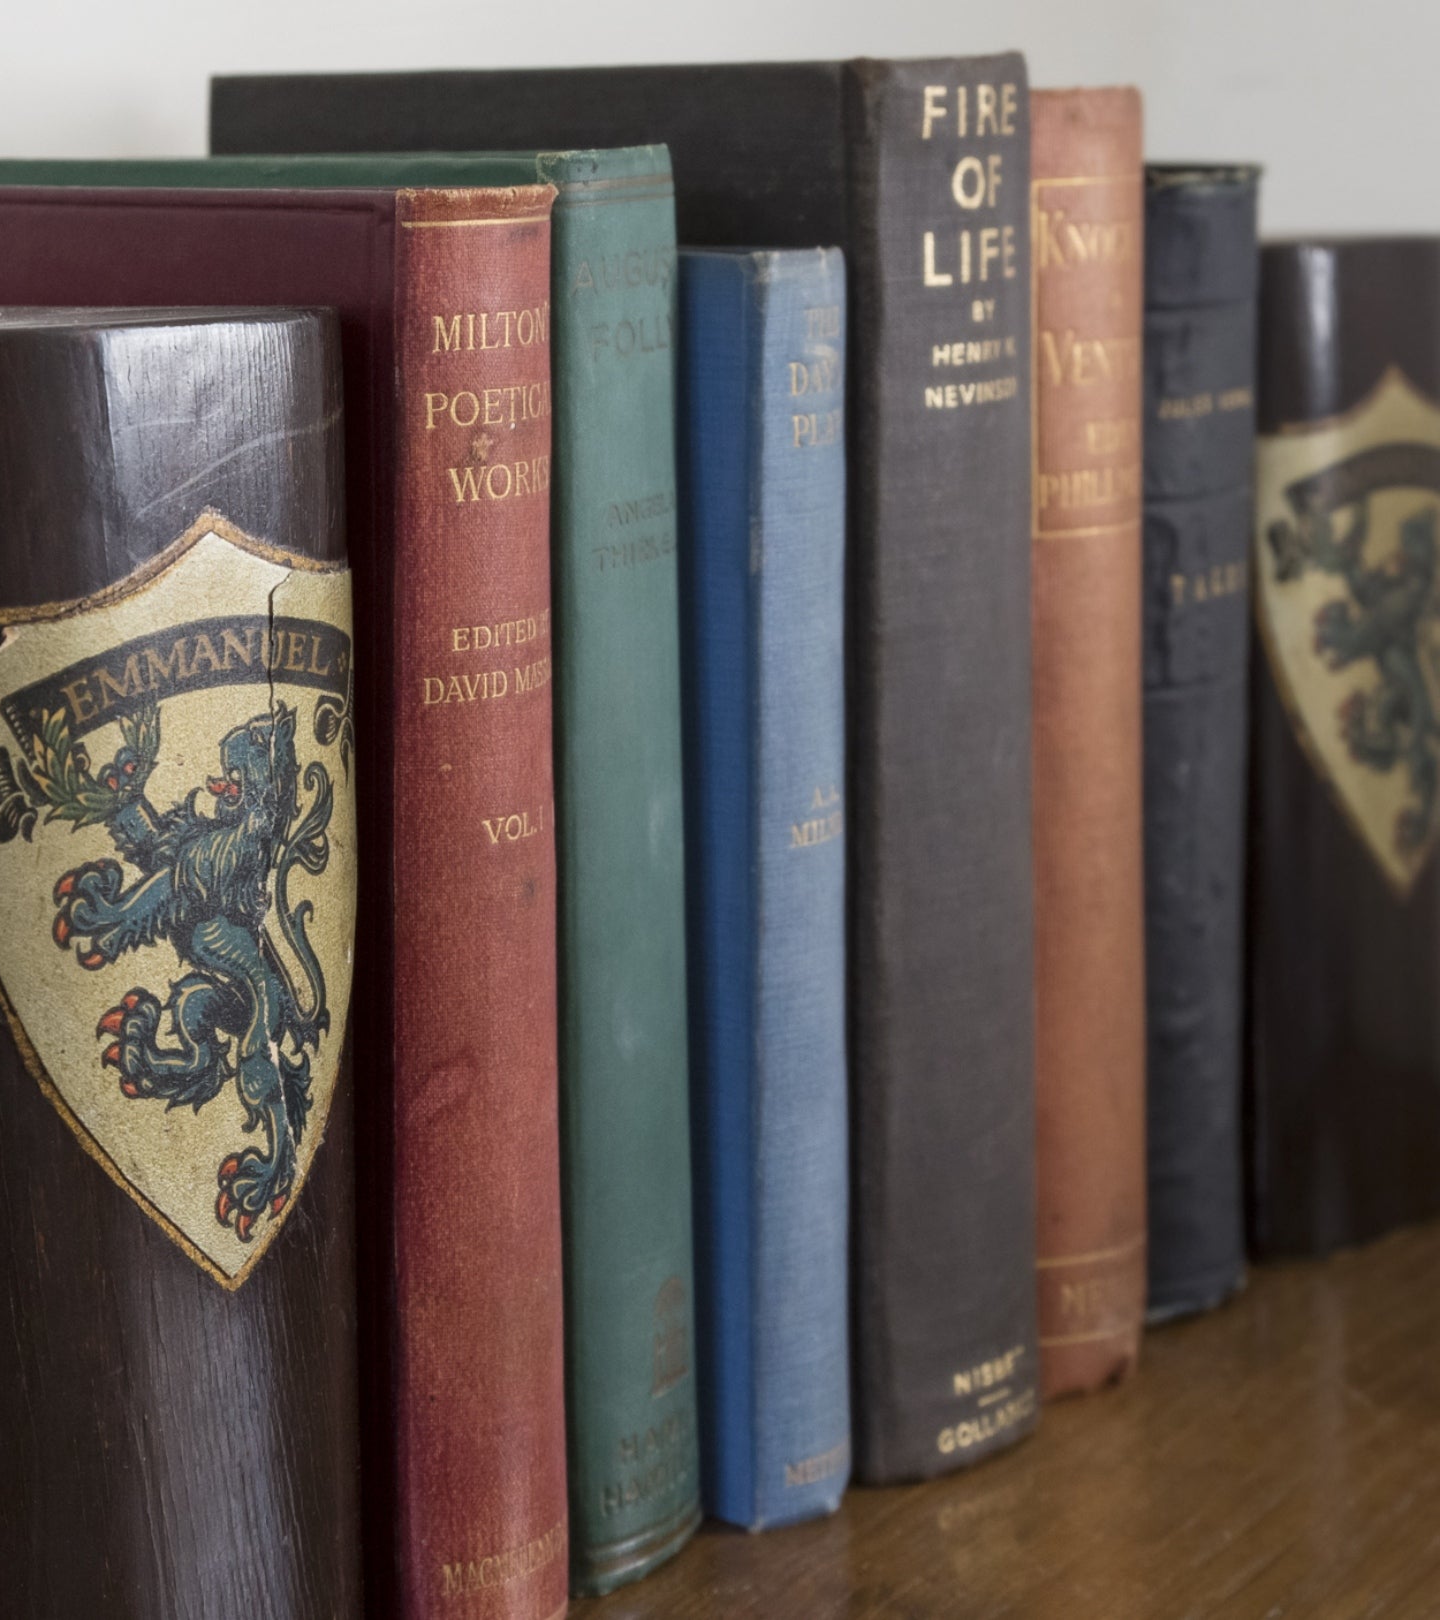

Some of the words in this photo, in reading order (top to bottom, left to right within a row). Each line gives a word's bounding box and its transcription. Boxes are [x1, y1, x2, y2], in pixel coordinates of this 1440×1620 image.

[922, 83, 1017, 139] FIRE
[952, 154, 1003, 209] OF
[923, 226, 1017, 286] LIFE
[972, 299, 996, 323] BY
[452, 617, 537, 653] EDITED
[62, 626, 331, 724] EMMANUEL
[423, 671, 508, 705] DAVID
